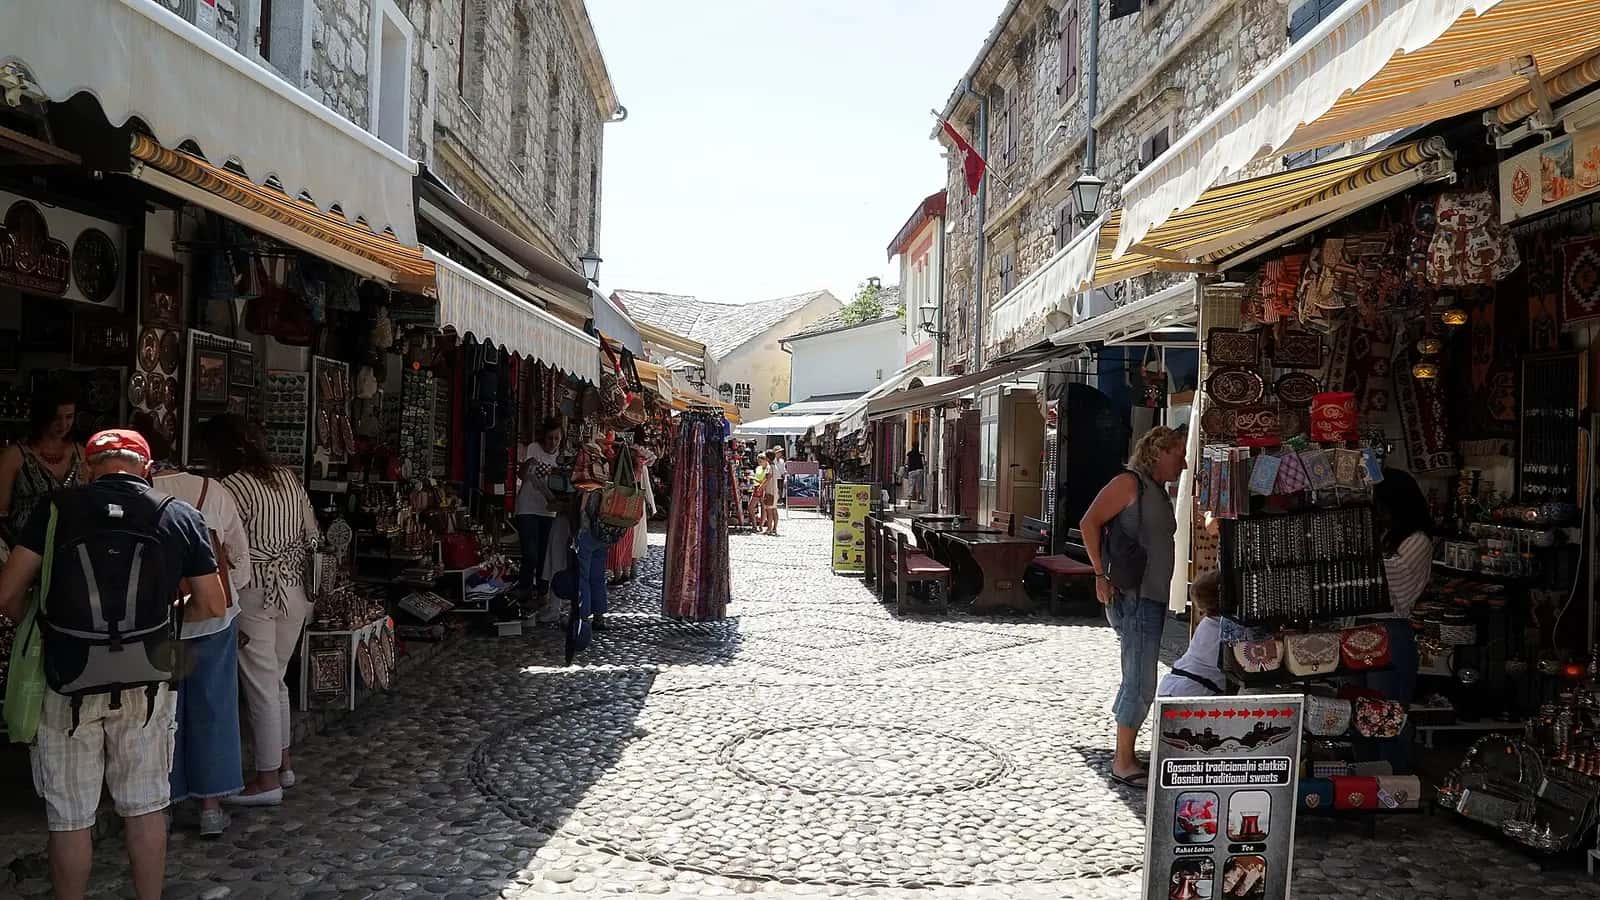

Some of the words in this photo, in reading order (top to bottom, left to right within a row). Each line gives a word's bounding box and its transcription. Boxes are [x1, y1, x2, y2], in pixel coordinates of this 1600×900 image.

[1167, 761, 1204, 773] Bosanski
[1205, 760, 1256, 772] tradicionalni
[1171, 773, 1204, 785] Bosnian
[1205, 772, 1248, 784] traditional
[1249, 773, 1279, 783] sweets
